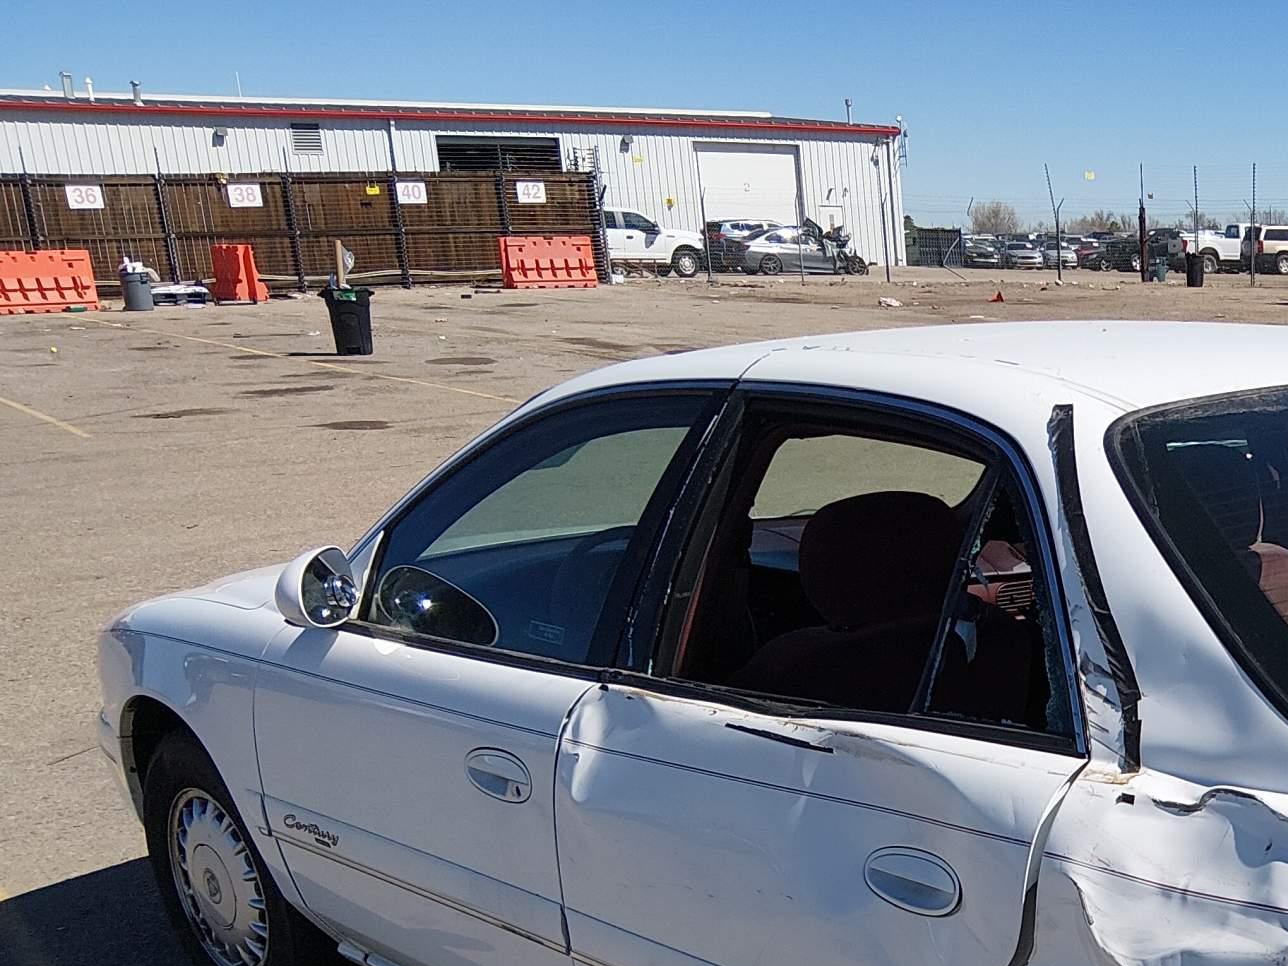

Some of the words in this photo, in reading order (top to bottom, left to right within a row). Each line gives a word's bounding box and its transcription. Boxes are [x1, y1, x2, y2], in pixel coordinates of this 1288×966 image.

[72, 187, 97, 204] 36
[234, 186, 257, 202] 38
[402, 184, 421, 200] 40
[522, 184, 542, 199] 42
[284, 814, 339, 846] Century
